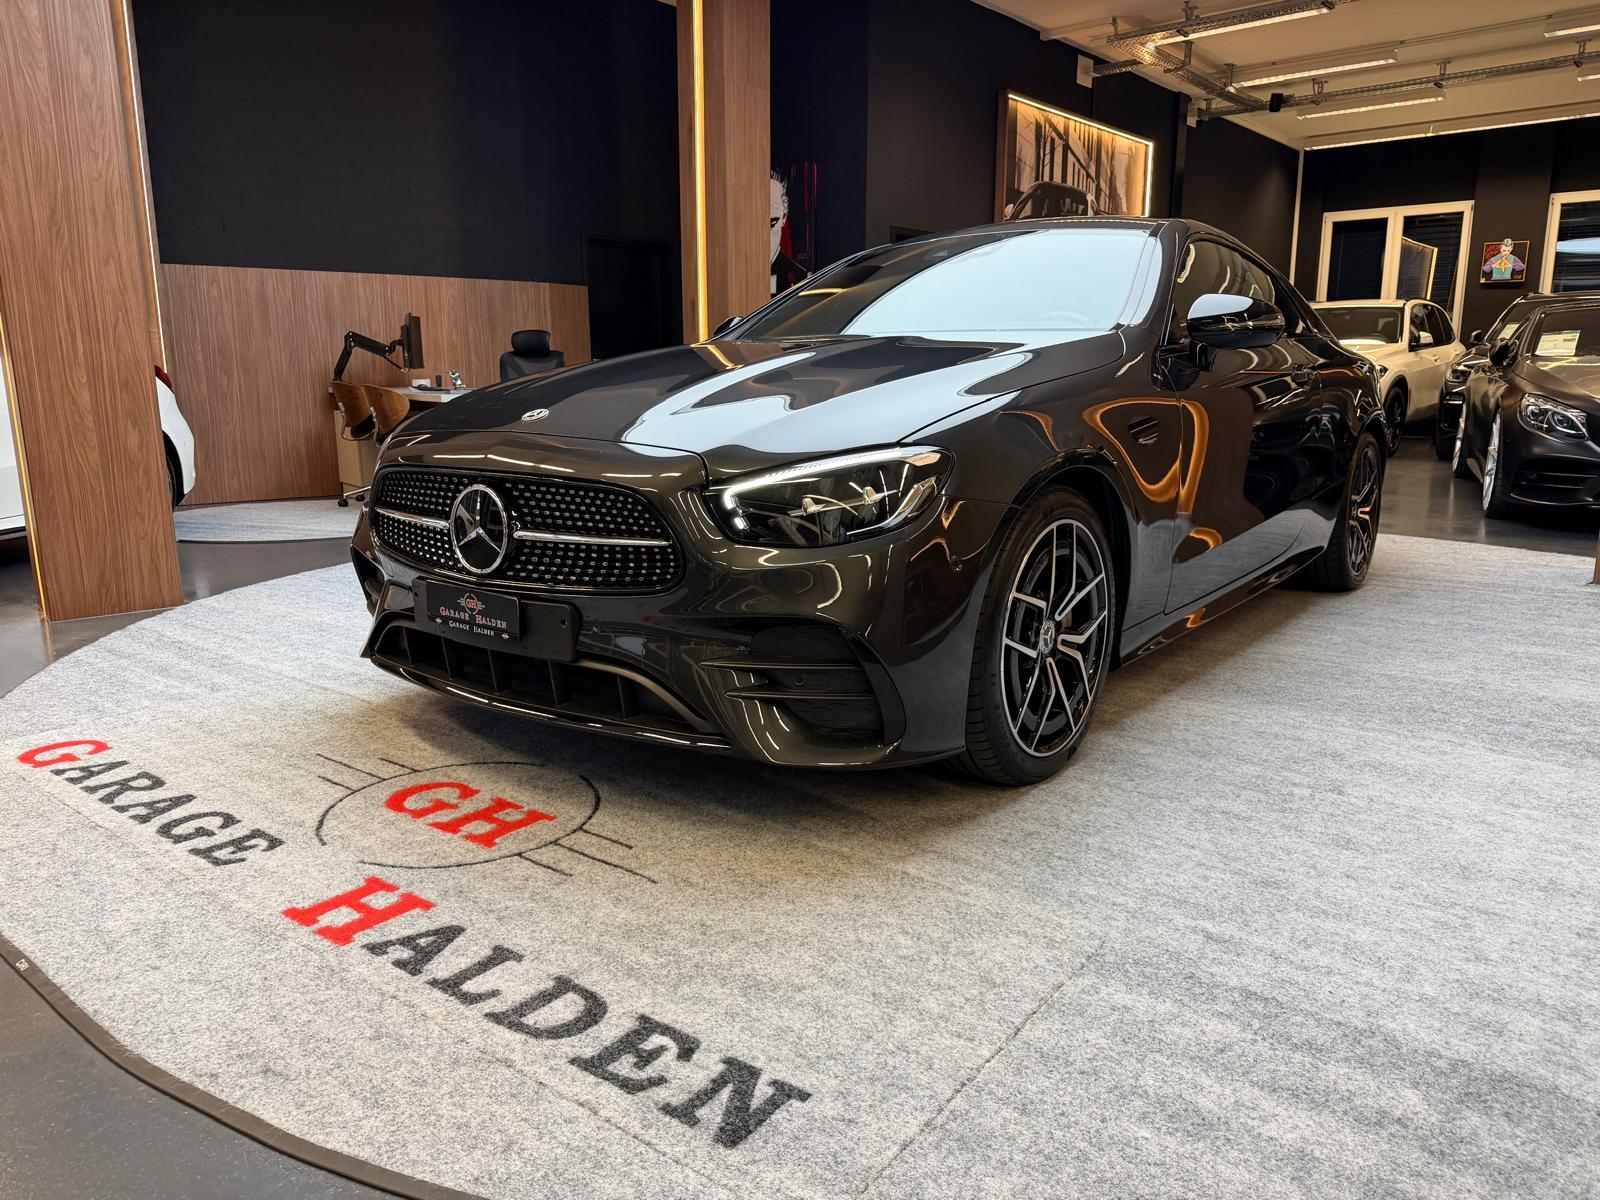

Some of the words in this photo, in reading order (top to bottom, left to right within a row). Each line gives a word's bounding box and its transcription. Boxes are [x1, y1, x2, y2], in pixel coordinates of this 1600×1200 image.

[465, 598, 477, 609] GH
[439, 606, 470, 621] GARAGE
[475, 614, 507, 629] HALDEN
[448, 620, 470, 631] GARAGE
[473, 625, 495, 636] HALDEN
[384, 781, 555, 848] GH
[17, 739, 285, 867] GARAGE
[281, 876, 812, 1148] HALDEN
